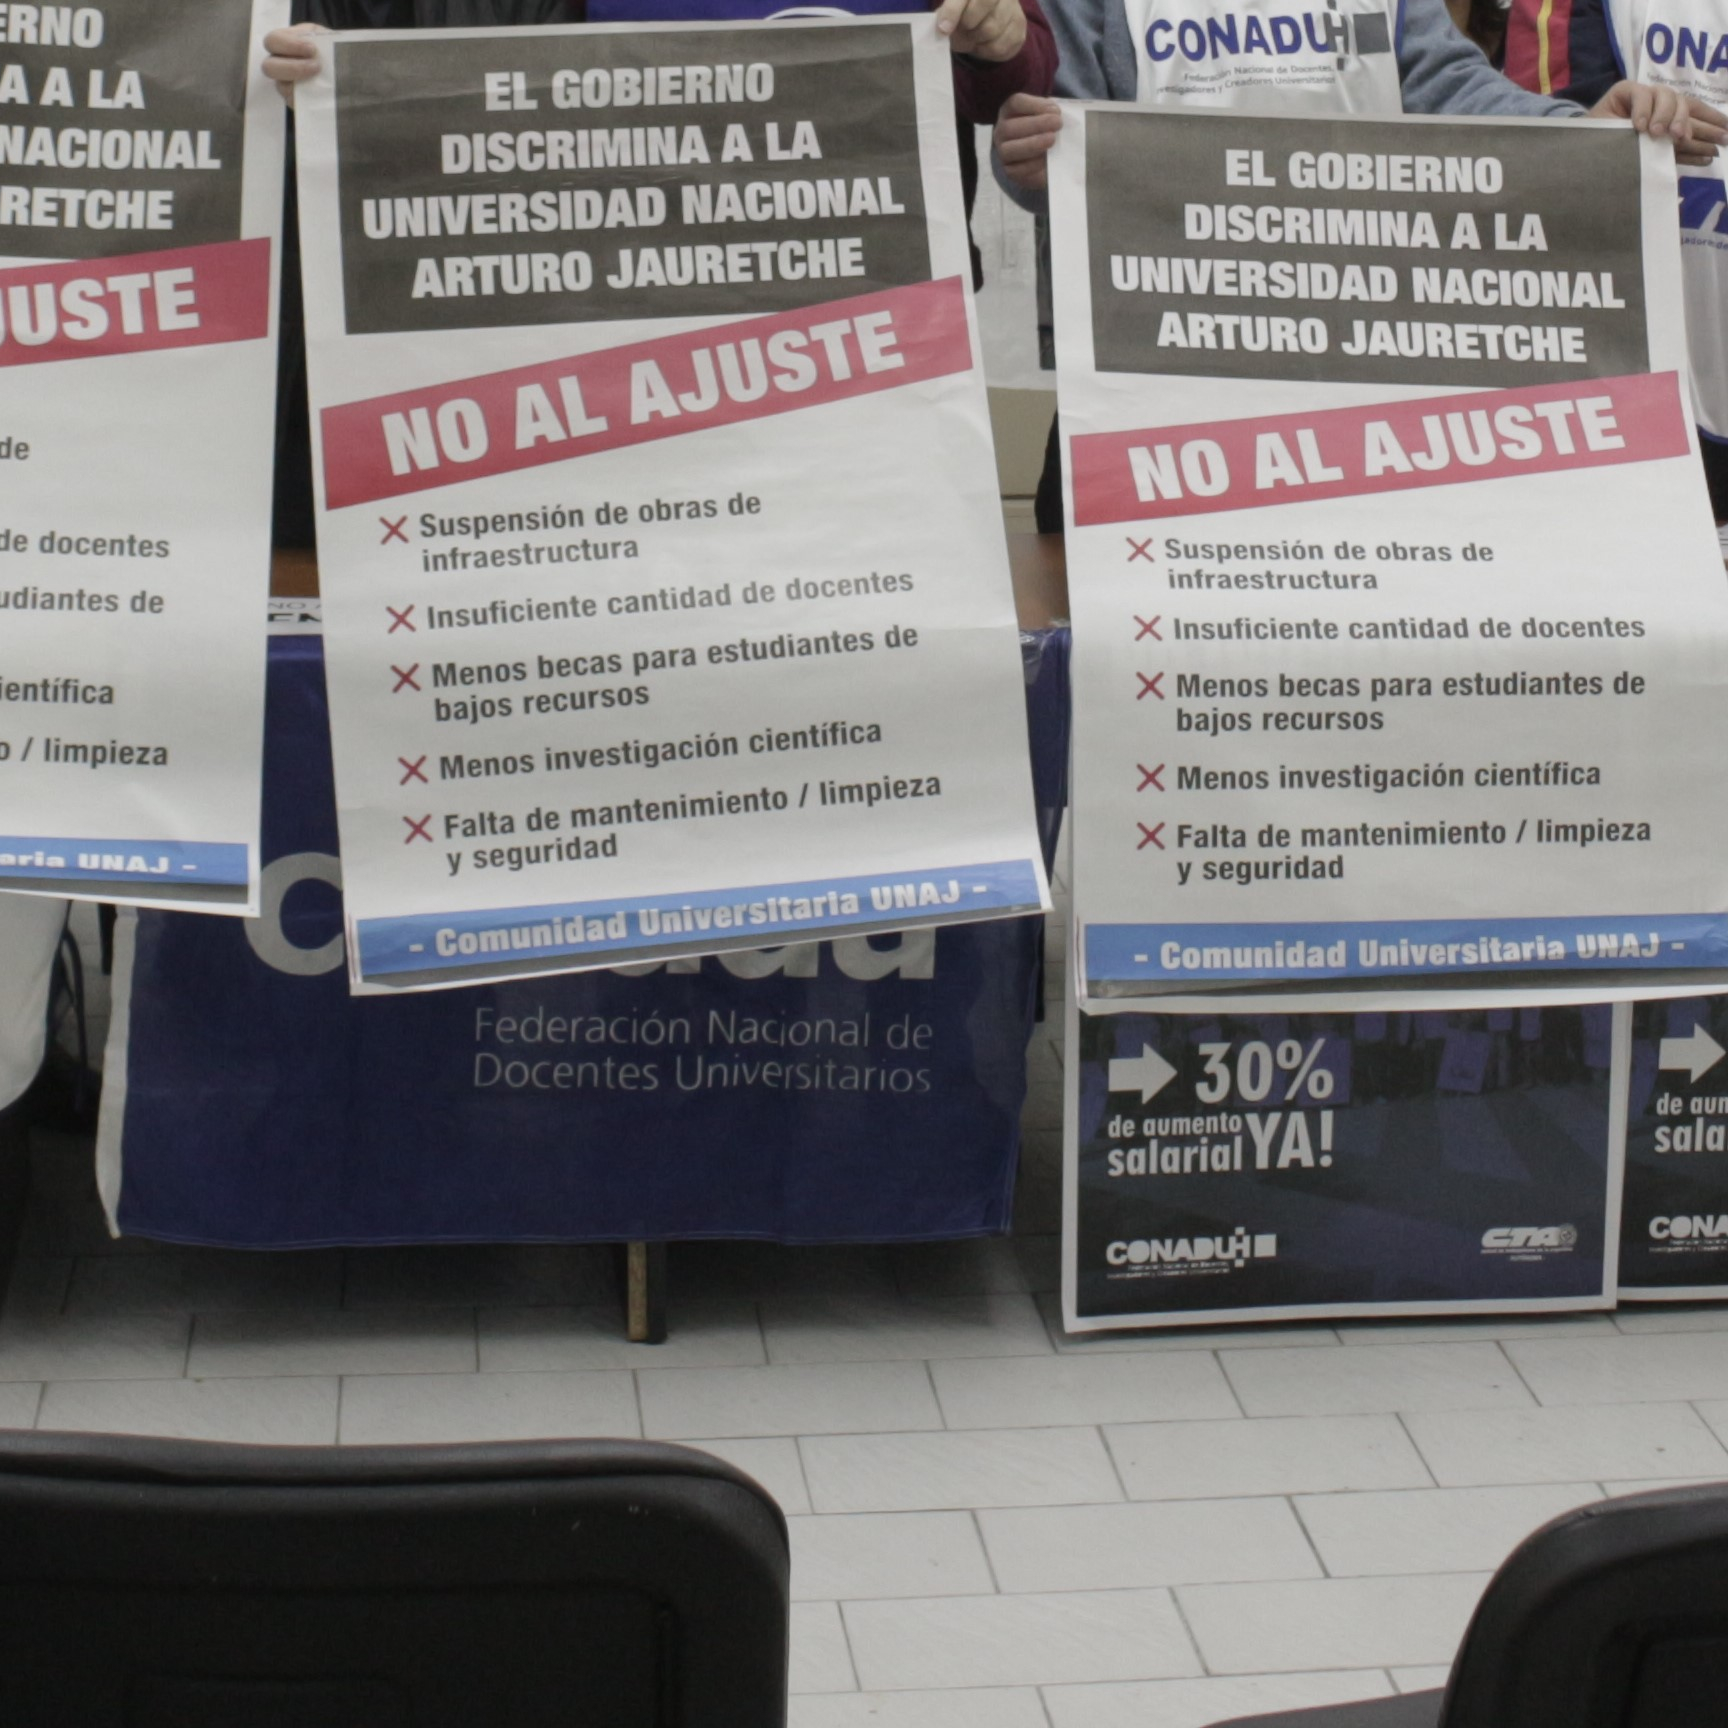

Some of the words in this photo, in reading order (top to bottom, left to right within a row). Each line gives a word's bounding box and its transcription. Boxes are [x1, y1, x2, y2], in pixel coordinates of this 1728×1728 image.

[39, 66, 74, 107] A
[88, 69, 145, 109] LA
[1225, 149, 1276, 187] EL
[1288, 151, 1503, 194] GOBIERNO
[1184, 203, 1441, 249] DISCRIMINA
[1450, 212, 1482, 250] A
[1494, 212, 1549, 251] LA
[1110, 254, 1398, 302] UNIVERSIDAD
[1412, 266, 1626, 309] NACIONAL
[1156, 311, 1329, 354] ARTURO
[1341, 320, 1588, 363] JAURETCHE
[380, 399, 490, 476] NO
[513, 375, 609, 451] AL
[629, 309, 905, 425] AJUSTE
[1128, 438, 1231, 503] NO
[1254, 428, 1344, 490] AL
[1364, 396, 1627, 479] AJUSTE
[435, 914, 628, 960] Comunidad
[637, 889, 861, 938] Universitaria
[870, 880, 962, 913] UNAJ
[1160, 940, 1346, 970] Comunidad
[1358, 934, 1566, 967] Universitaria
[1575, 931, 1660, 958] UNAJ
[475, 1004, 691, 1046] Federación
[708, 1009, 870, 1047] Nacional
[886, 1013, 933, 1050] de
[474, 1052, 659, 1091] Docentes
[676, 1053, 931, 1093] Universitarios
[1195, 1038, 1334, 1103] 30%
[1108, 1115, 1135, 1138] de
[1143, 1112, 1242, 1137] aumento
[1656, 1092, 1683, 1115] de
[1108, 1136, 1242, 1177] salarial
[1244, 1109, 1334, 1169] YA!
